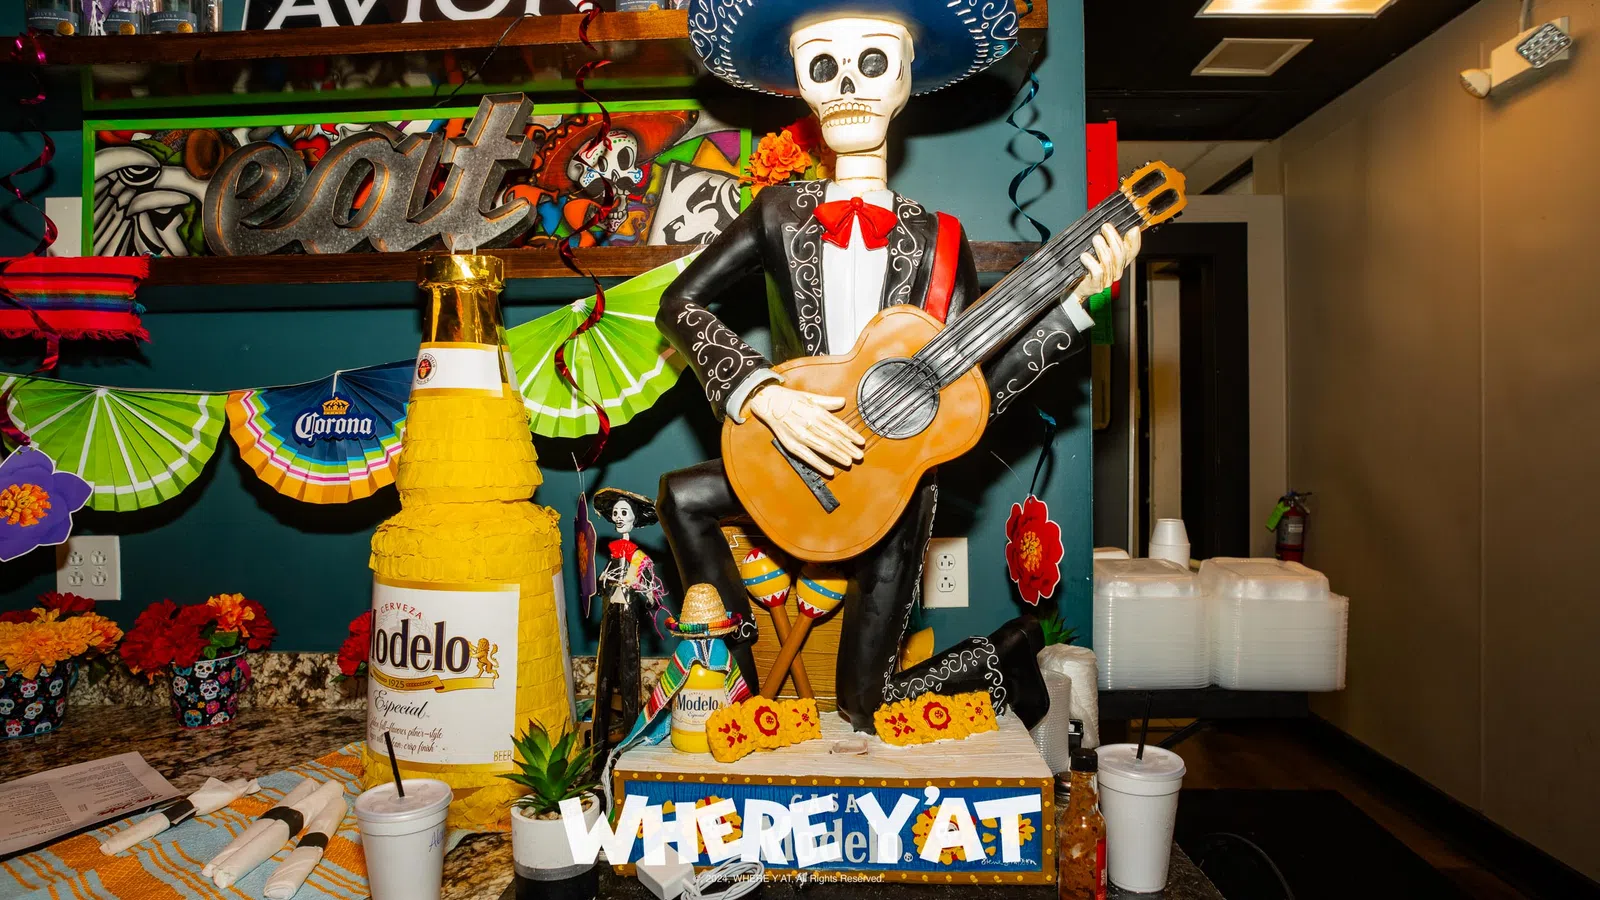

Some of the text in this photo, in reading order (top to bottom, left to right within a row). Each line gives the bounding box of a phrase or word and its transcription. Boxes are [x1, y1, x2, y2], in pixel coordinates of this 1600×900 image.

[263, 0, 595, 30] AVI
[203, 91, 537, 257] eat
[295, 412, 373, 441] Corona
[380, 602, 422, 619] CERVEZA
[388, 679, 405, 688] 1925
[373, 690, 427, 719] Especial
[677, 693, 719, 711] Modelo
[493, 750, 513, 761] BEER
